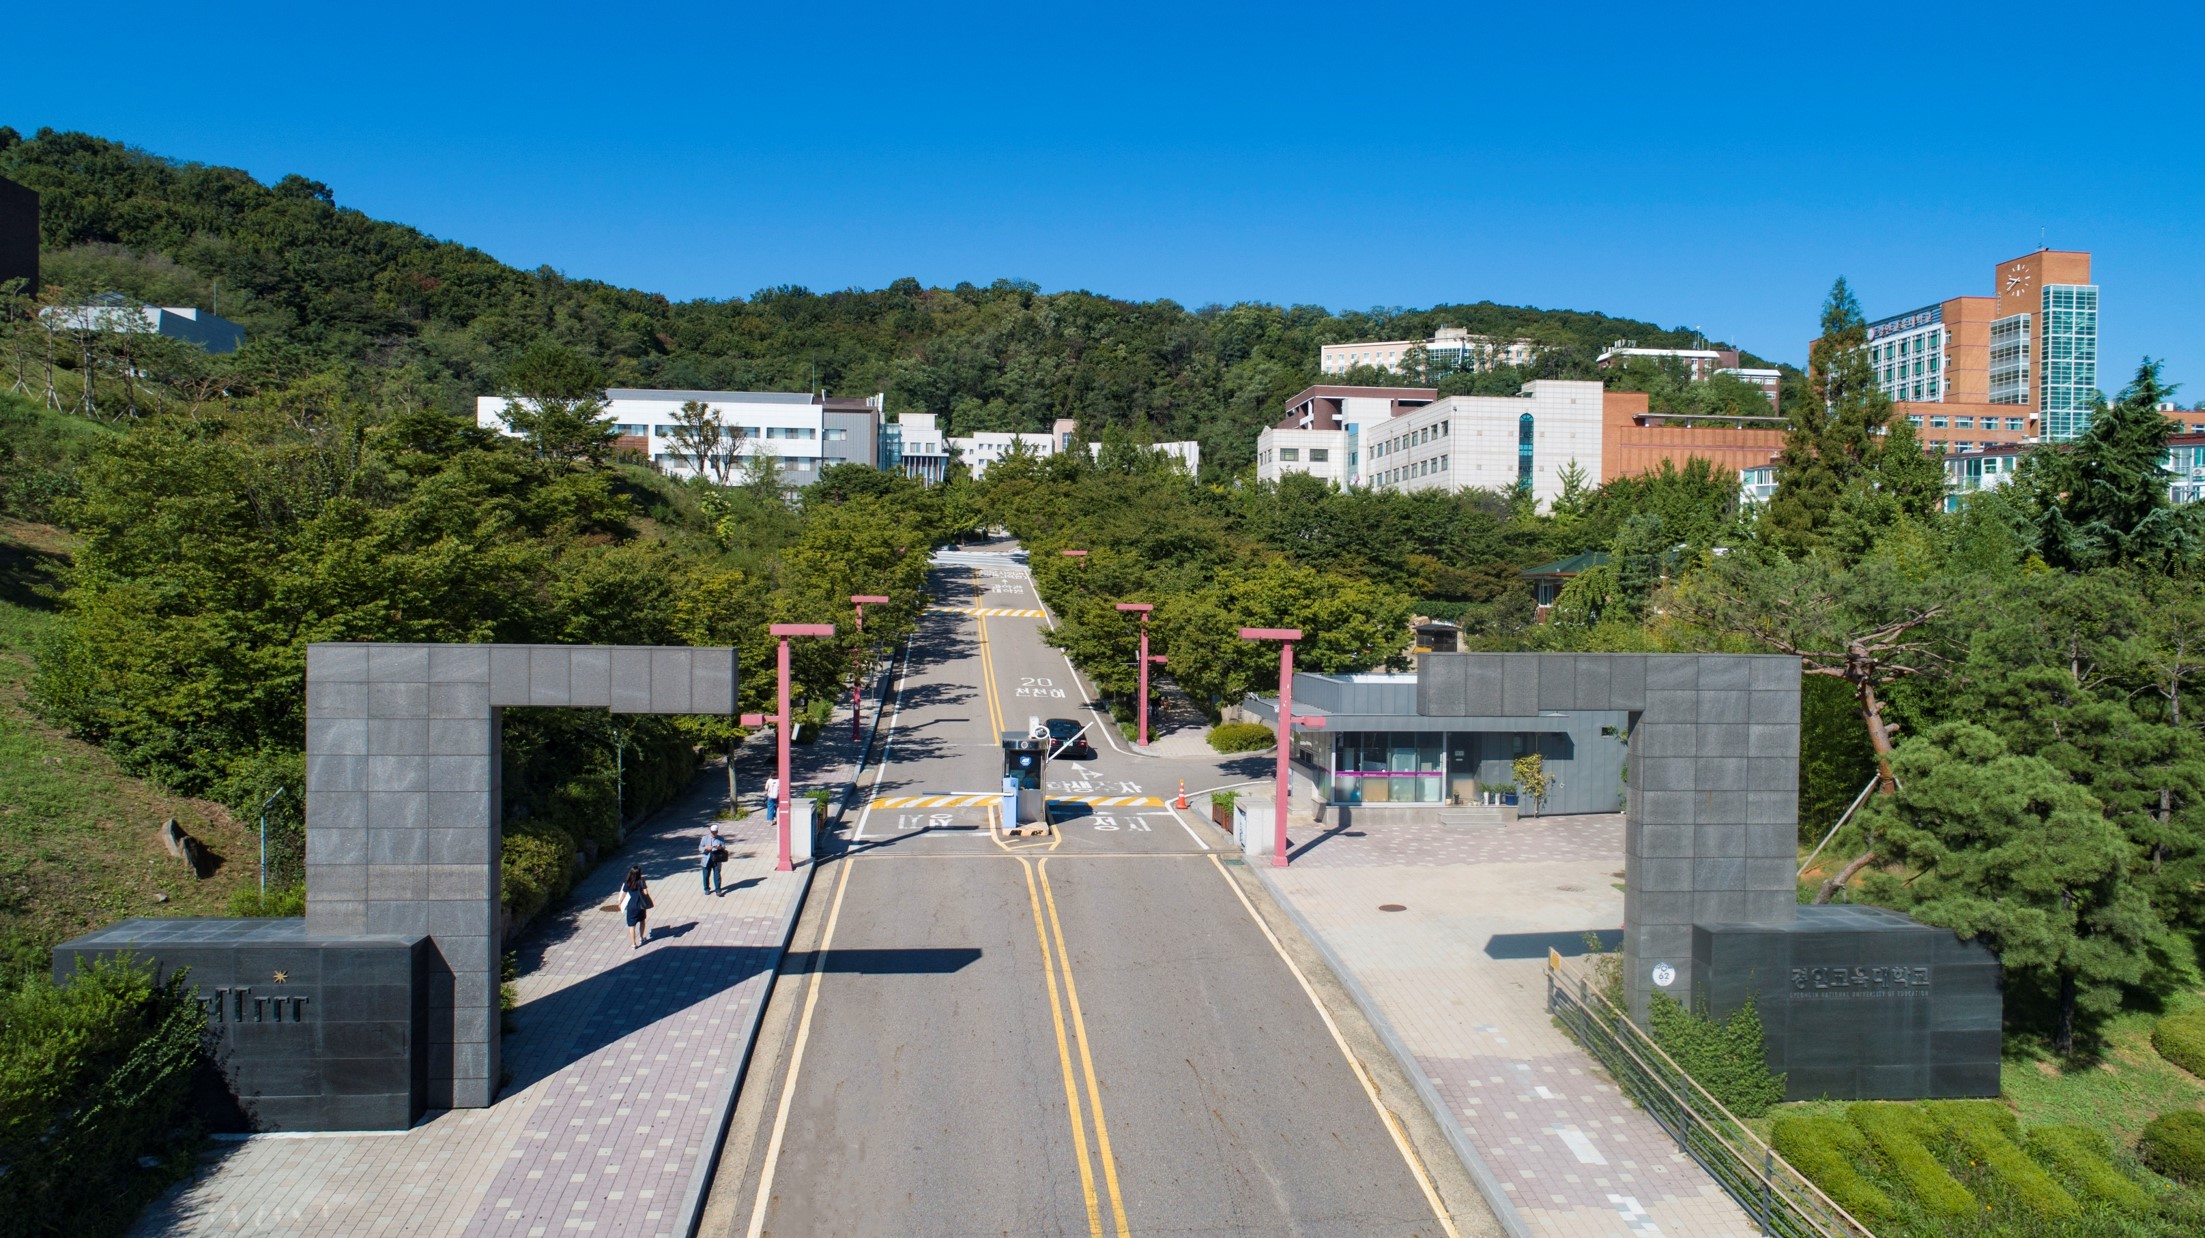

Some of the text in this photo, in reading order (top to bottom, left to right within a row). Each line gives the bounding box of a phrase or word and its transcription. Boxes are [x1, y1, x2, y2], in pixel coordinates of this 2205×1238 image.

[1020, 677, 1053, 687] 20
[1015, 687, 1066, 699] 천천히
[1088, 816, 1152, 832] 정지
[1658, 972, 1670, 980] 62
[1791, 966, 1930, 989] 경인교육대학교
